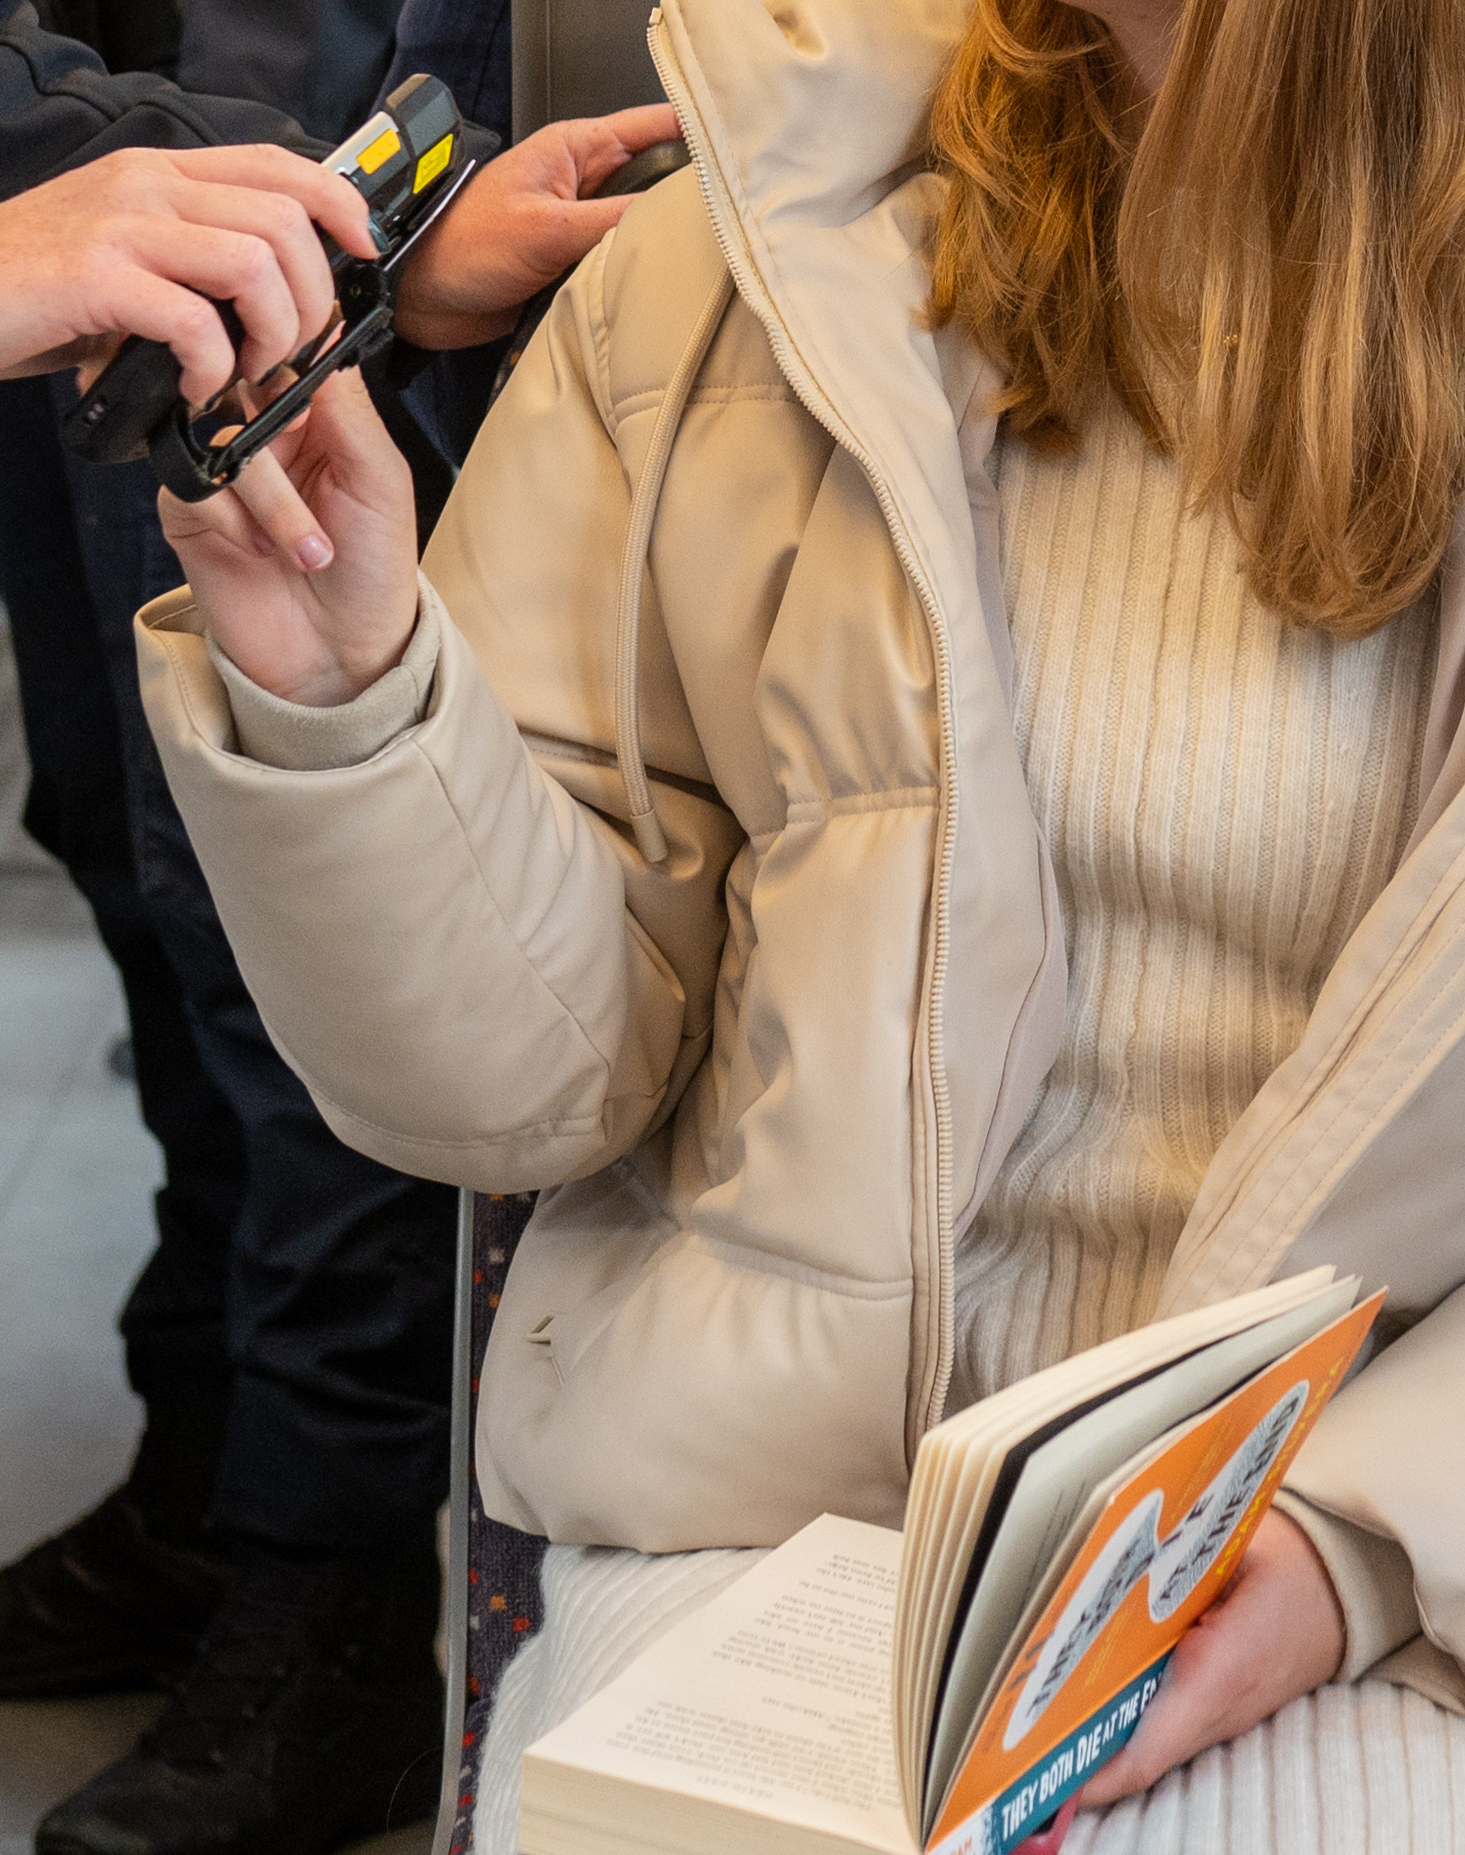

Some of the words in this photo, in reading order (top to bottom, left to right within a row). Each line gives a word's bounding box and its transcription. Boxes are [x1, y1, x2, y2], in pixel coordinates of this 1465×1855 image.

[1192, 1485, 1252, 1566] THE
[1001, 1779, 1039, 1842] THEY
[1039, 1747, 1074, 1805] BOTH
[1076, 1720, 1103, 1775] DIE
[1102, 1711, 1118, 1745] AT
[1118, 1691, 1141, 1731] THE
